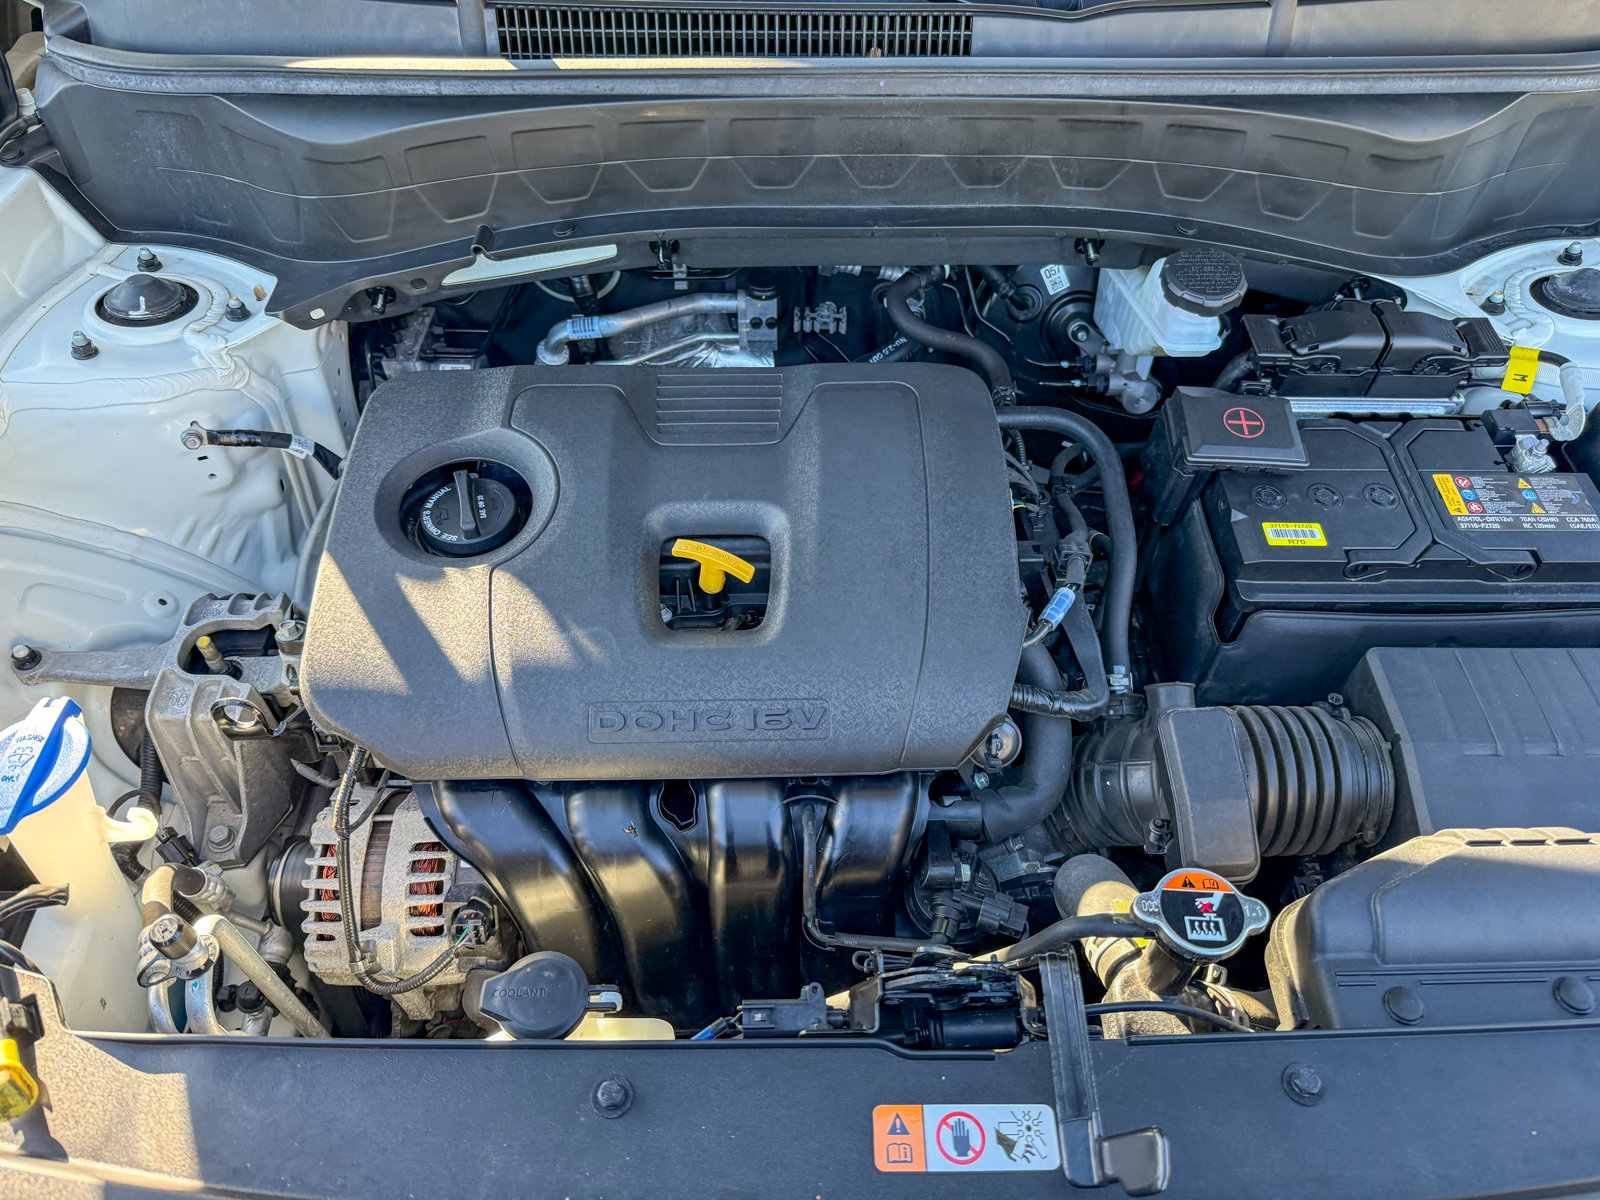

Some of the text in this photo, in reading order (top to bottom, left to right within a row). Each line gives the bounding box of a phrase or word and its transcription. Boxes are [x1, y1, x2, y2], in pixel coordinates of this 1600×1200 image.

[1512, 373, 1529, 382] M
[422, 486, 458, 541] SEE OWNER'S MANUAL
[479, 508, 487, 519] SAE
[592, 707, 828, 733] DOHC 16V
[492, 987, 546, 998] COOLANT
